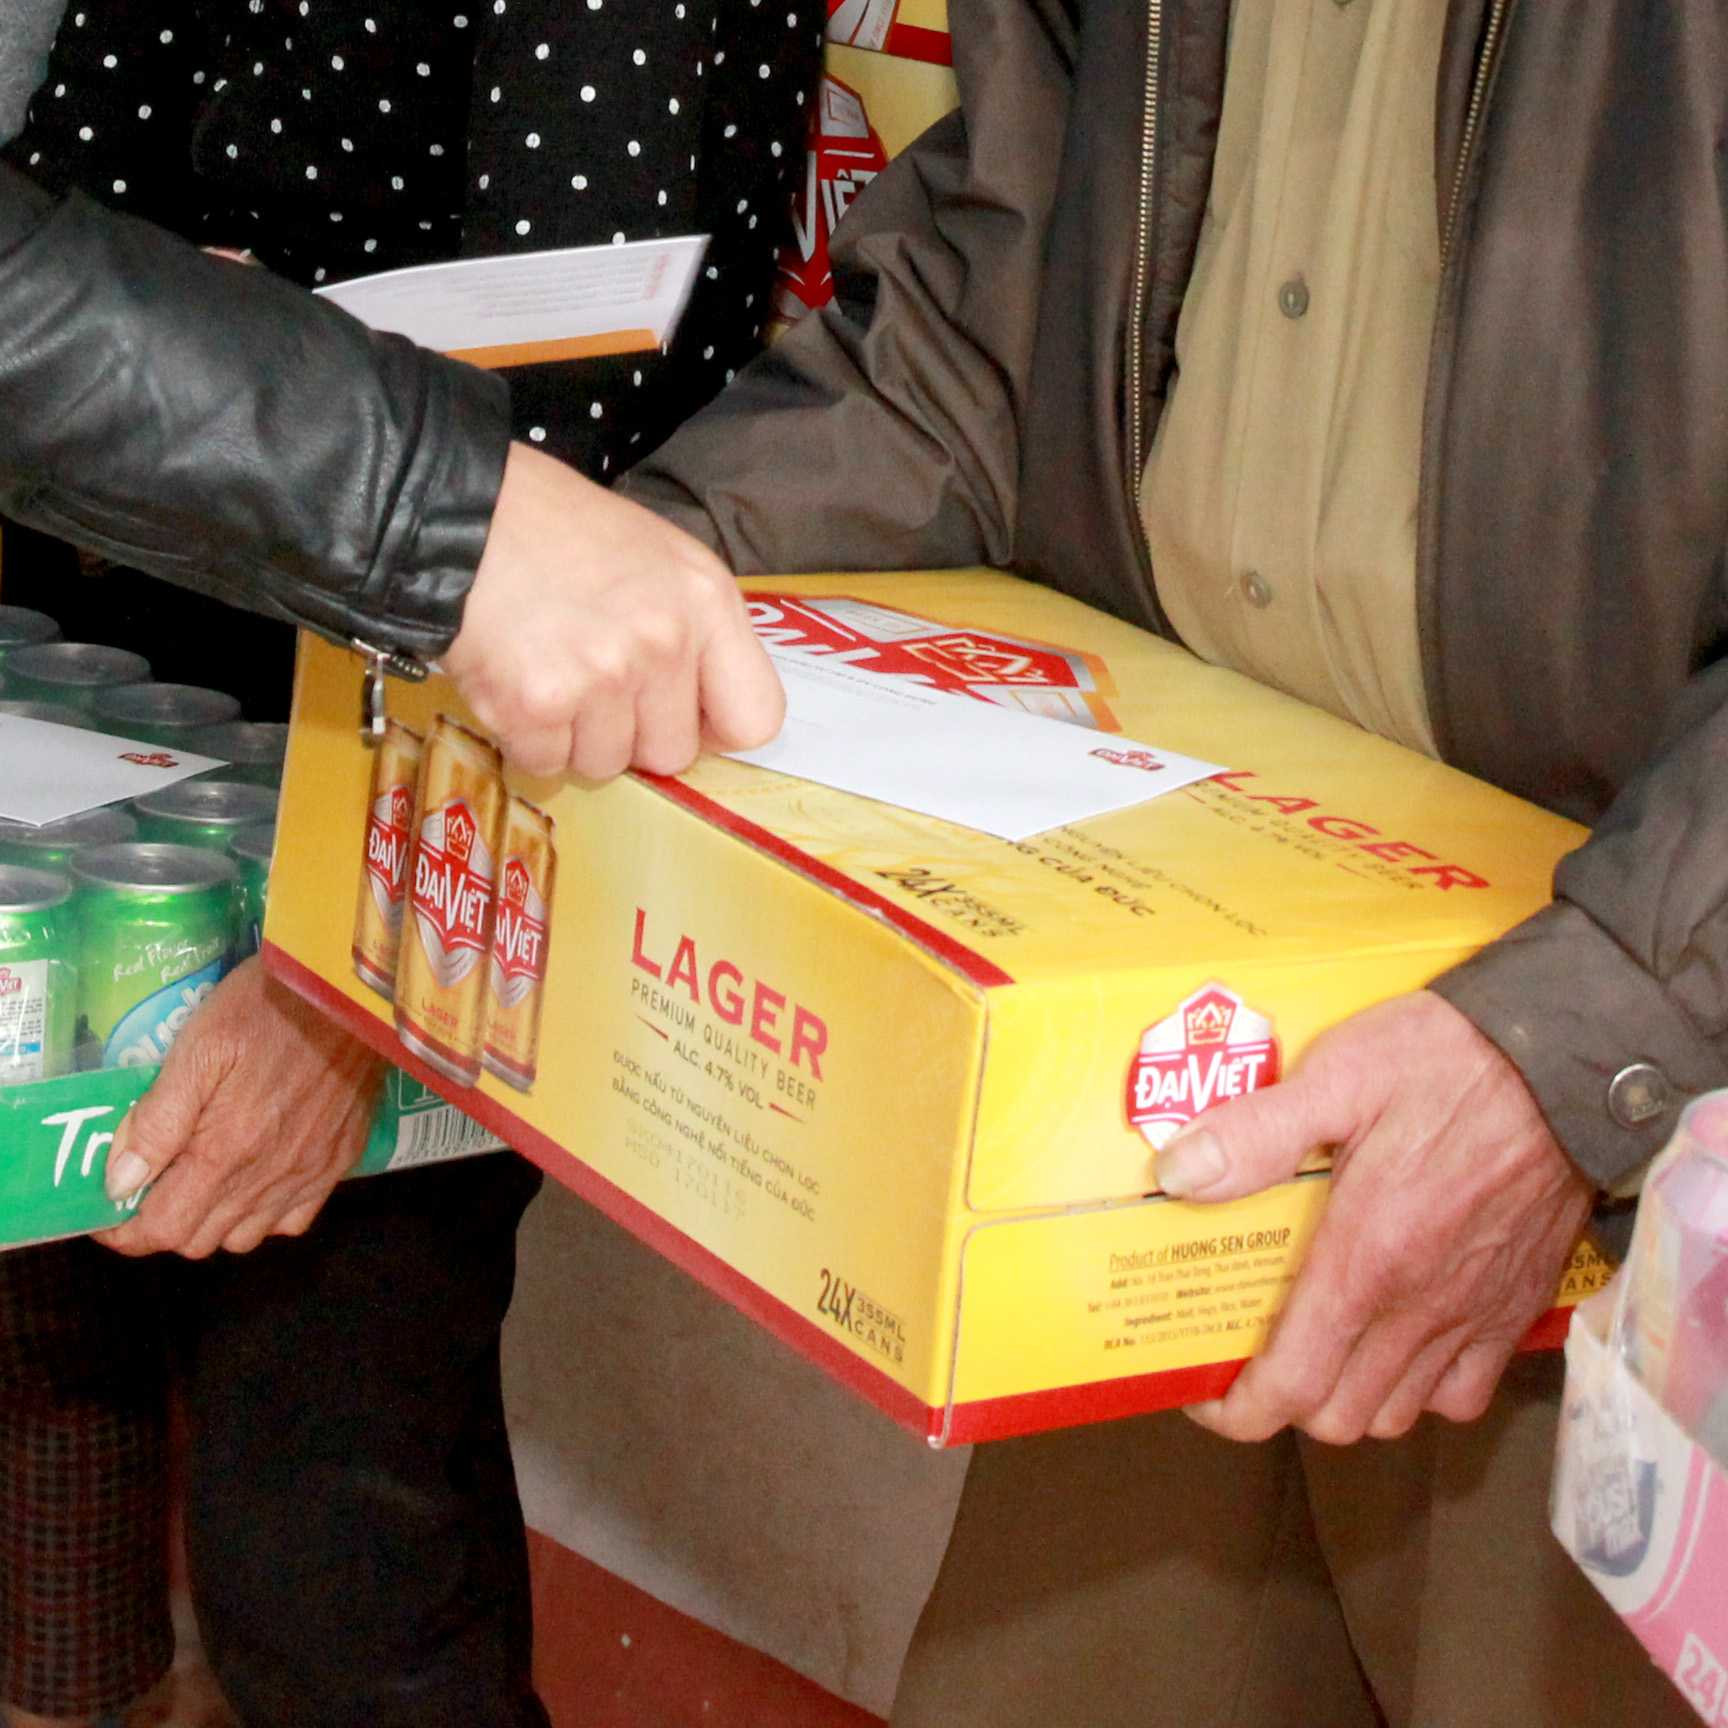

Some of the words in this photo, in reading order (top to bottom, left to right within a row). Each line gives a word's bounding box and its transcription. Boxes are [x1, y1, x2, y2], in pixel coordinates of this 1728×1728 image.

[1208, 771, 1491, 891] LAGER
[631, 907, 828, 1083] LAGER
[631, 977, 696, 1033] PREMIUM
[703, 1023, 769, 1080] QUALITY
[776, 1069, 817, 1111] BEER
[673, 1040, 702, 1069] ALC.
[705, 1061, 735, 1092] 4.7%
[738, 1081, 764, 1110] VOL
[41, 1104, 115, 1187] Tr
[642, 1098, 672, 1127] CÔNG
[675, 1119, 705, 1150] NGHỆ
[730, 1156, 762, 1188] TIẾNG
[765, 1179, 788, 1204] CỦA
[687, 1098, 731, 1136] NGUYÊN
[734, 1129, 760, 1155] LIỆU
[1110, 1251, 1154, 1271] Product
[1157, 1245, 1169, 1263] of
[1172, 1238, 1217, 1260] HUONG
[1220, 1235, 1244, 1253] SEN
[1246, 1227, 1291, 1249] GROUP
[1564, 1274, 1612, 1291] ANS
[818, 1268, 856, 1333] 24X
[857, 1297, 906, 1343] 355ML
[855, 1319, 903, 1363] CANS
